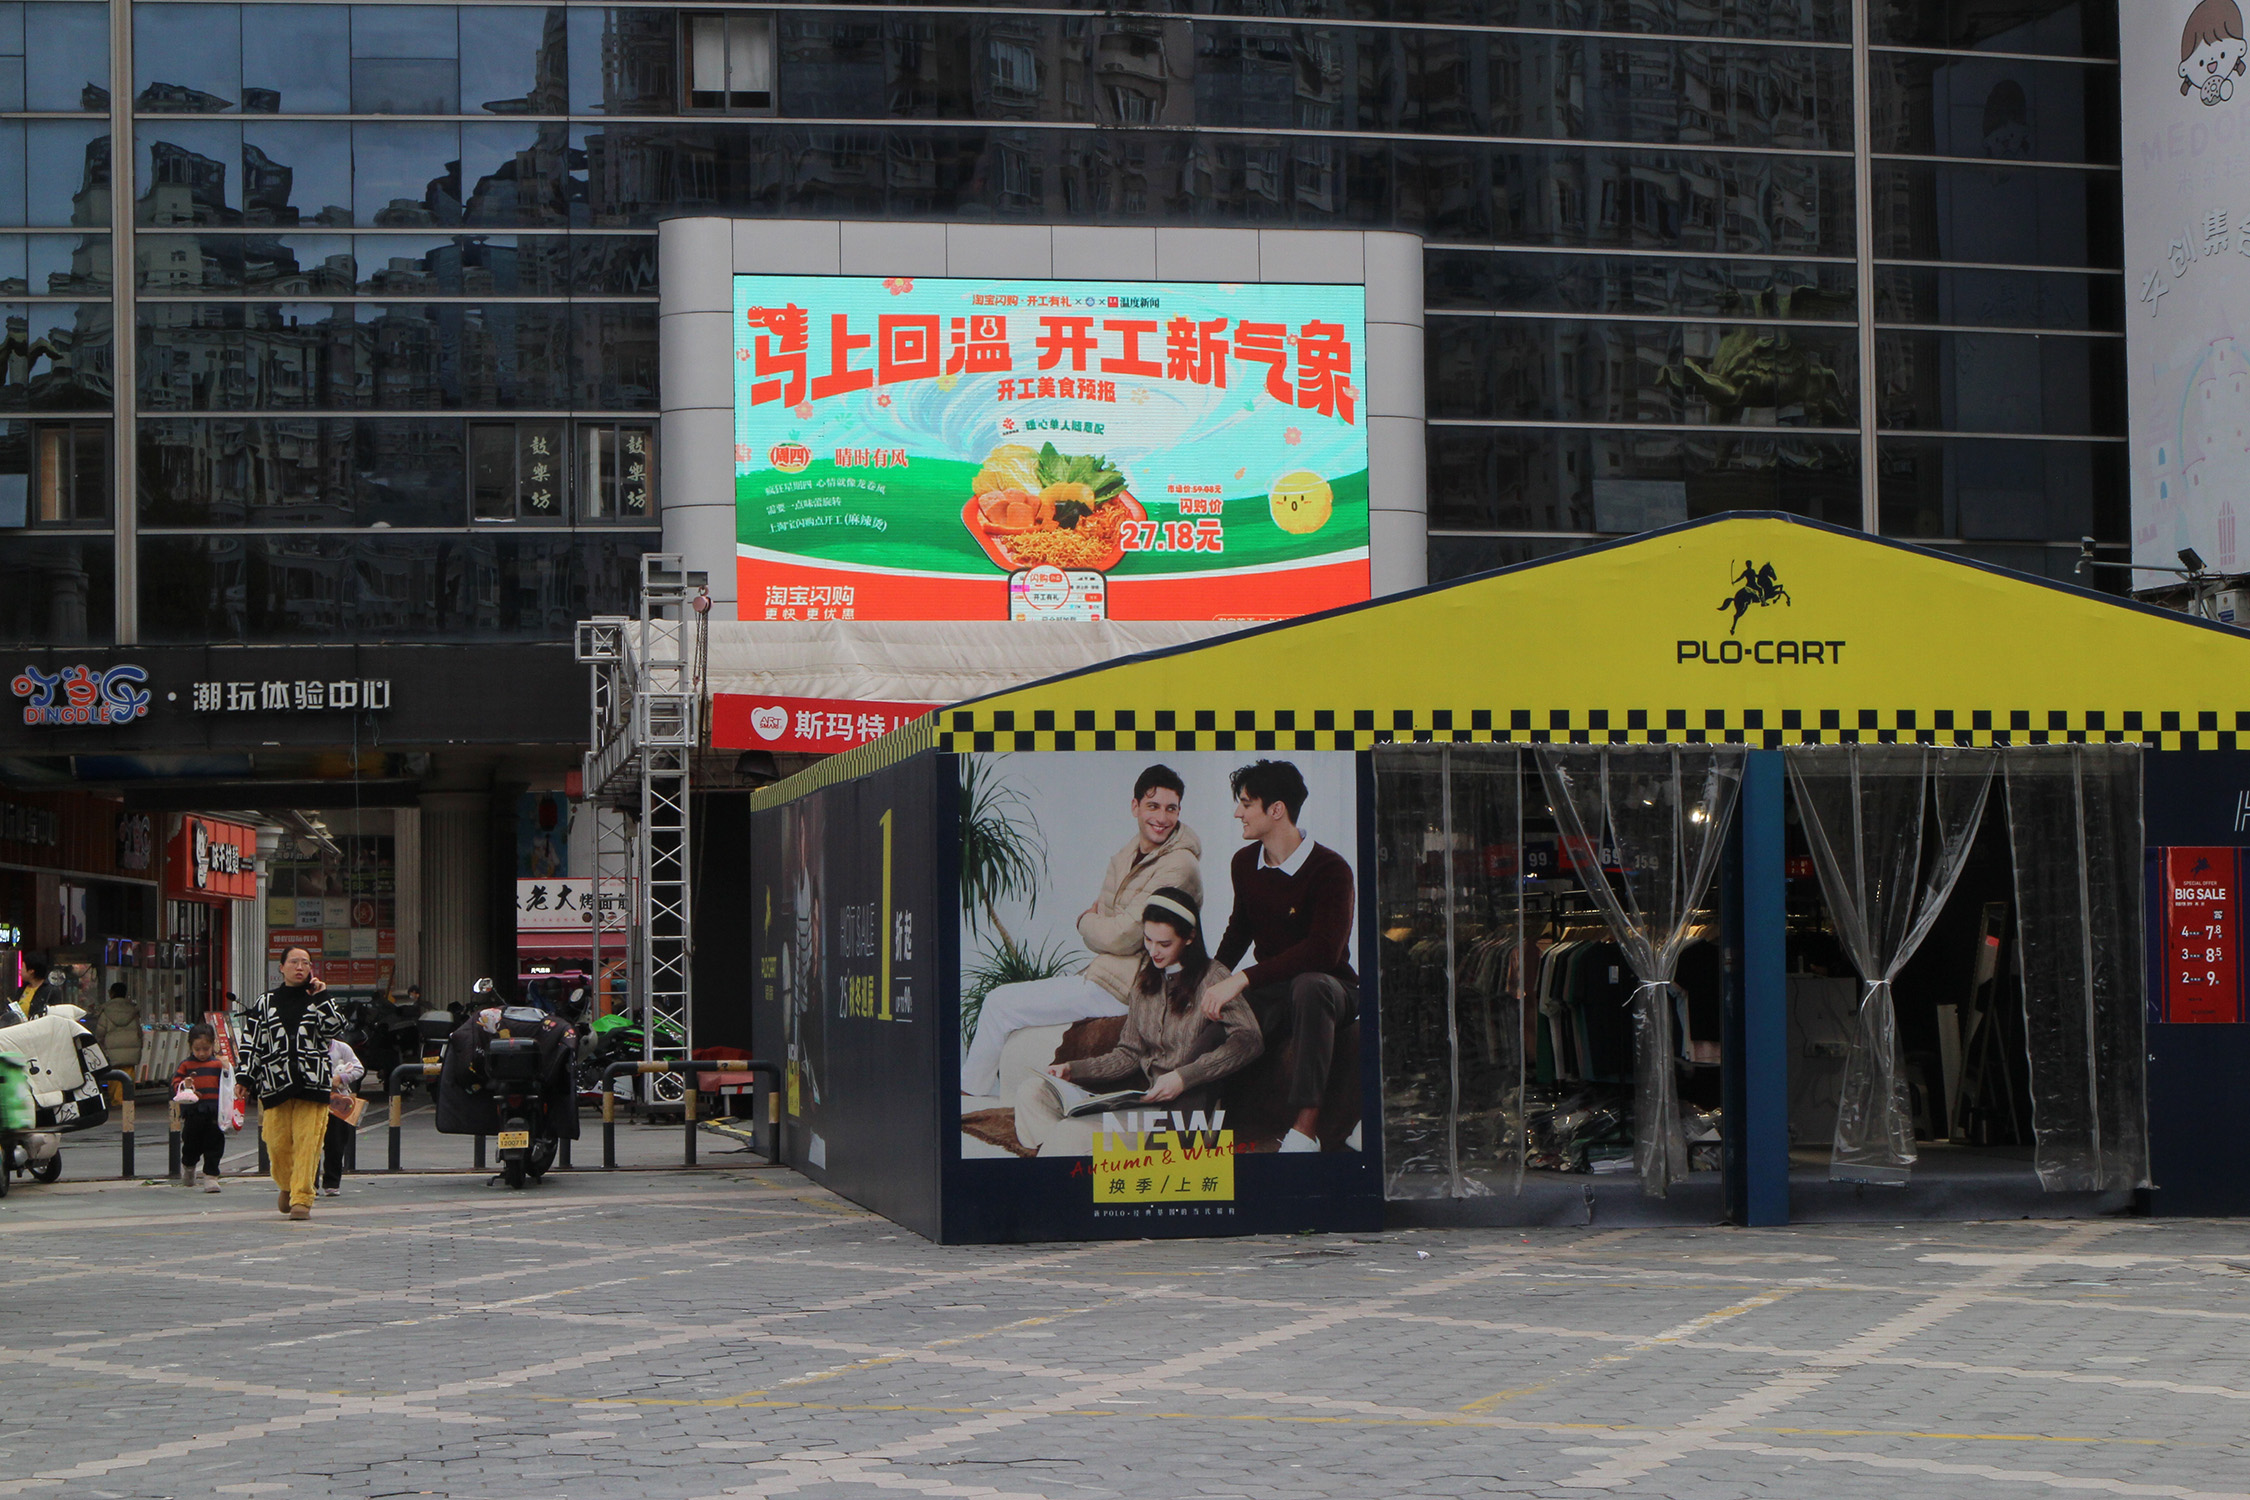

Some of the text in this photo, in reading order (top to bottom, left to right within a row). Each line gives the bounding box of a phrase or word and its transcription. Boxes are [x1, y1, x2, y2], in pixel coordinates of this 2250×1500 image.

[1036, 316, 1355, 426] 开工新气象
[997, 376, 1116, 403] 开工美食预报
[835, 448, 909, 467] 晴时有风
[1179, 498, 1222, 514] 闪购价
[1121, 519, 1223, 552] 27.18元
[765, 585, 855, 606] 淘宝闪购
[193, 680, 391, 711] 潮玩体验中心
[794, 710, 909, 742] 斯玛特
[2175, 888, 2226, 900] BIG SALE
[1102, 1110, 1226, 1151] NEW
[1070, 1141, 1258, 1178] Autumn & Winter
